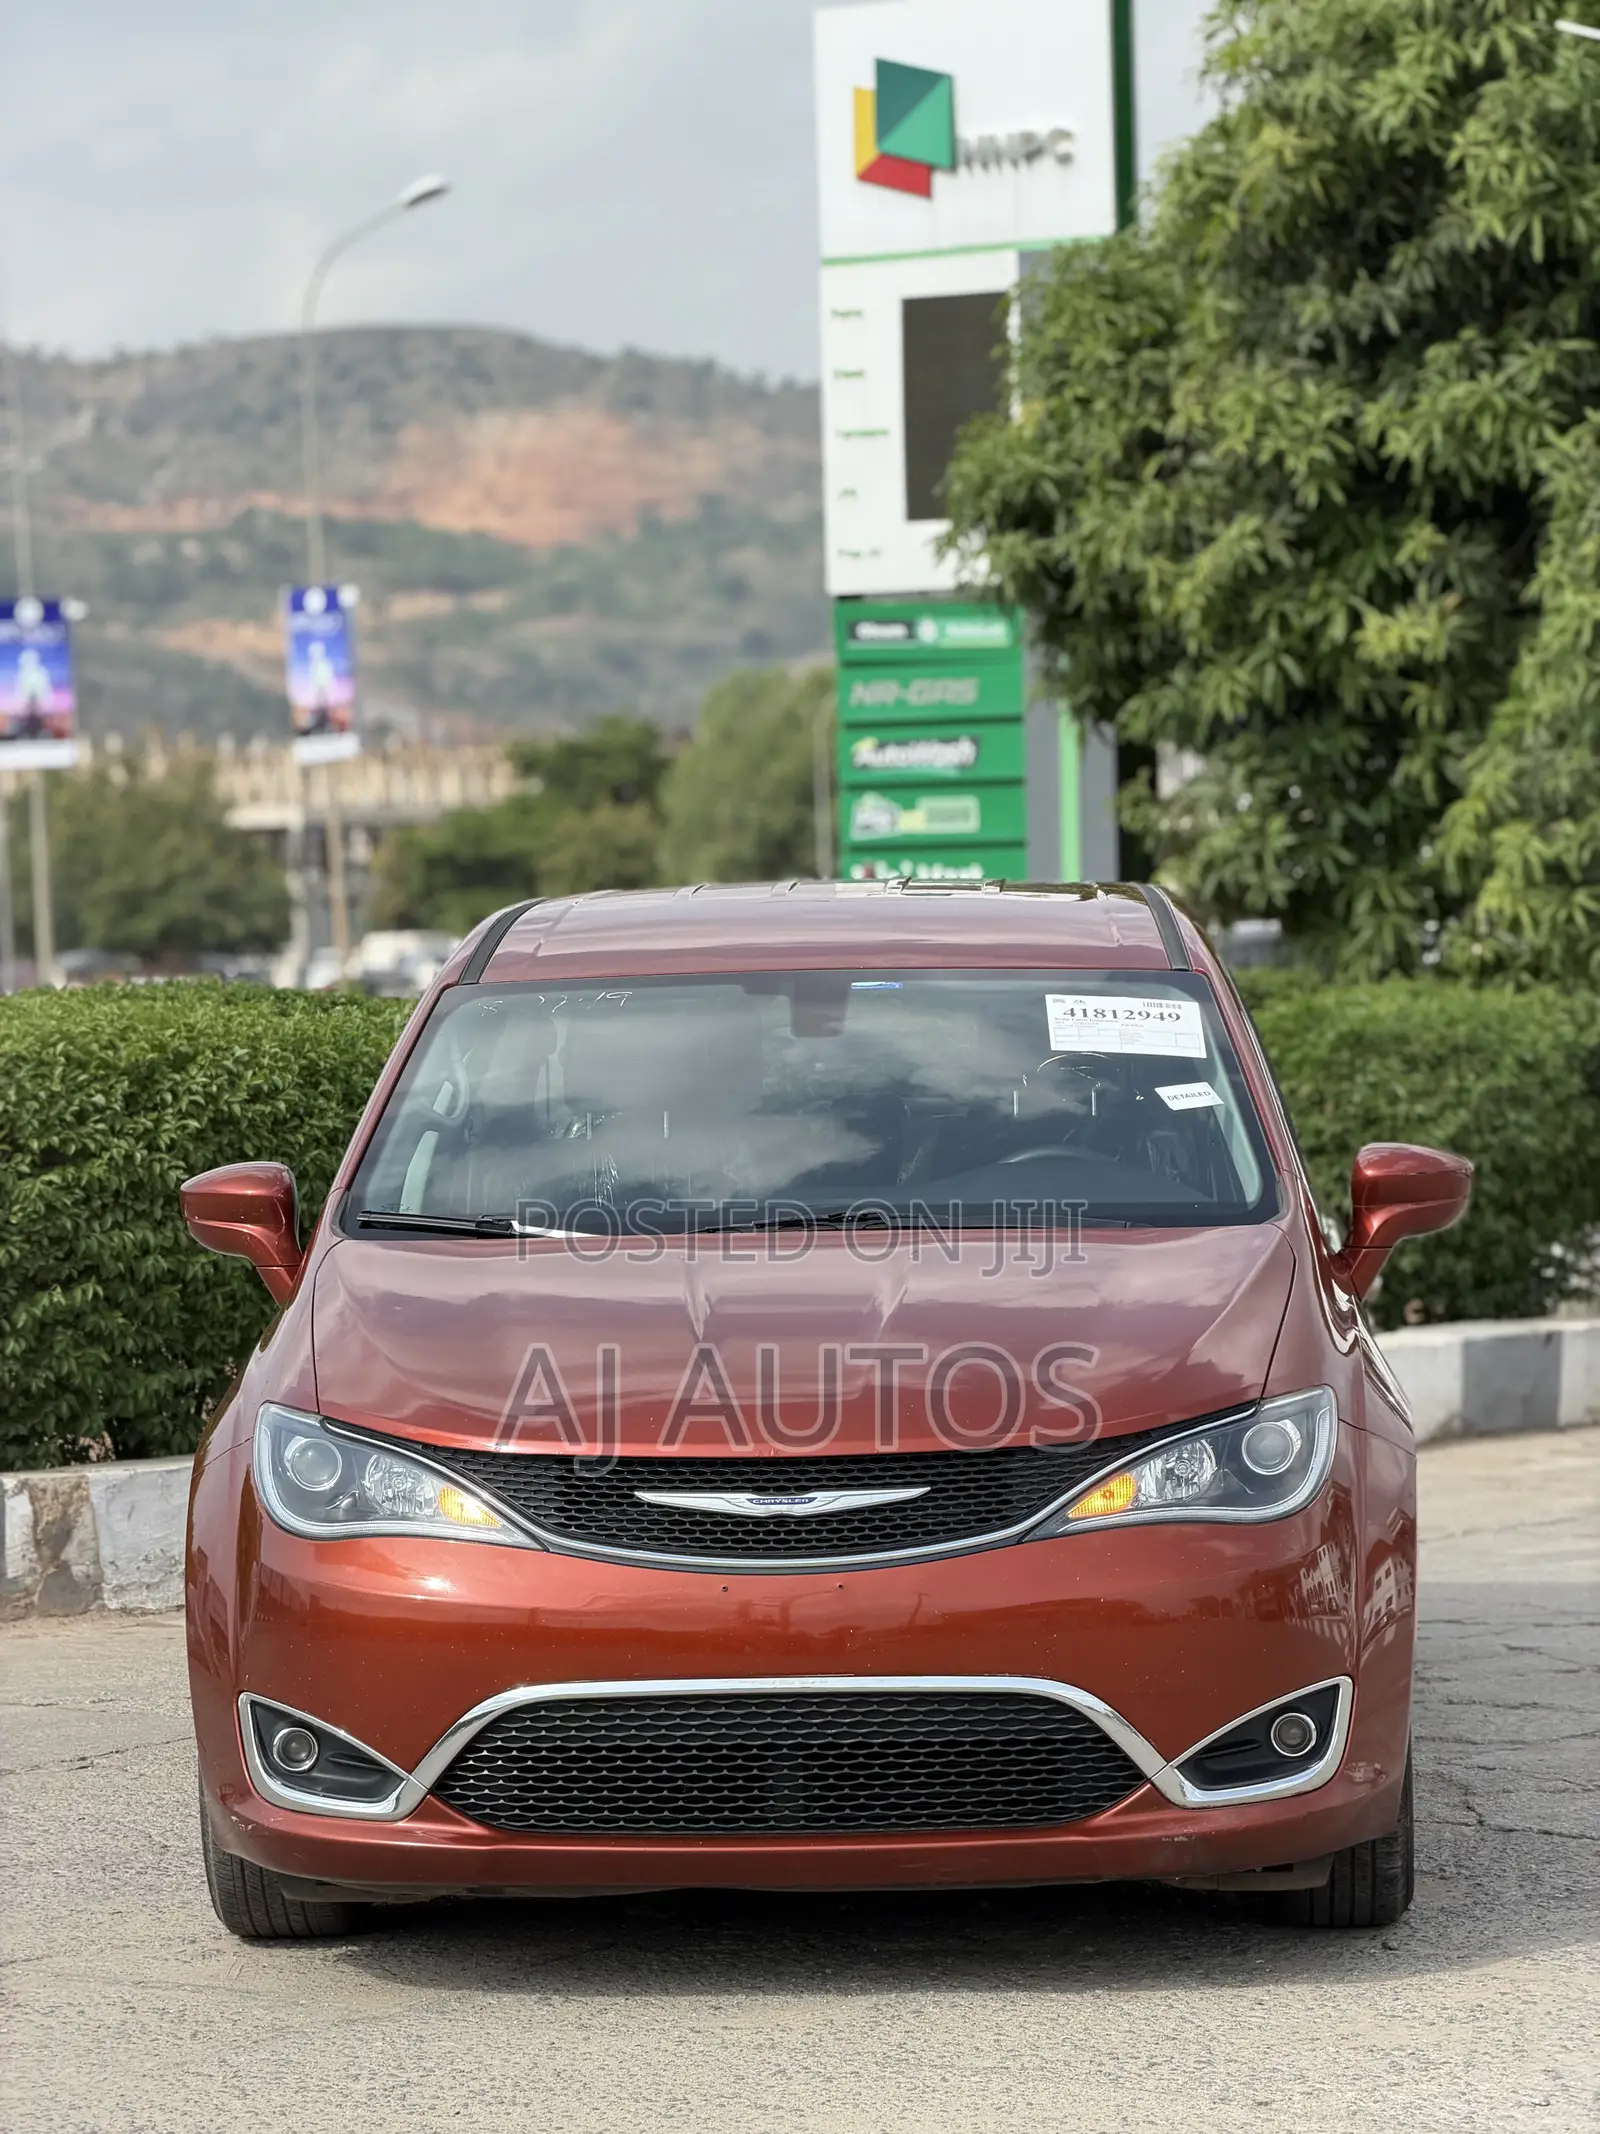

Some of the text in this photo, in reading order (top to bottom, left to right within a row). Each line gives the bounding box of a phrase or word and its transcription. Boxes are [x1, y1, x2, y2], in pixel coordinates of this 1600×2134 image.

[1062, 1006, 1182, 1023] 41812949
[1166, 1090, 1211, 1102] DETAILED
[751, 1497, 810, 1505] CHRYSLER
